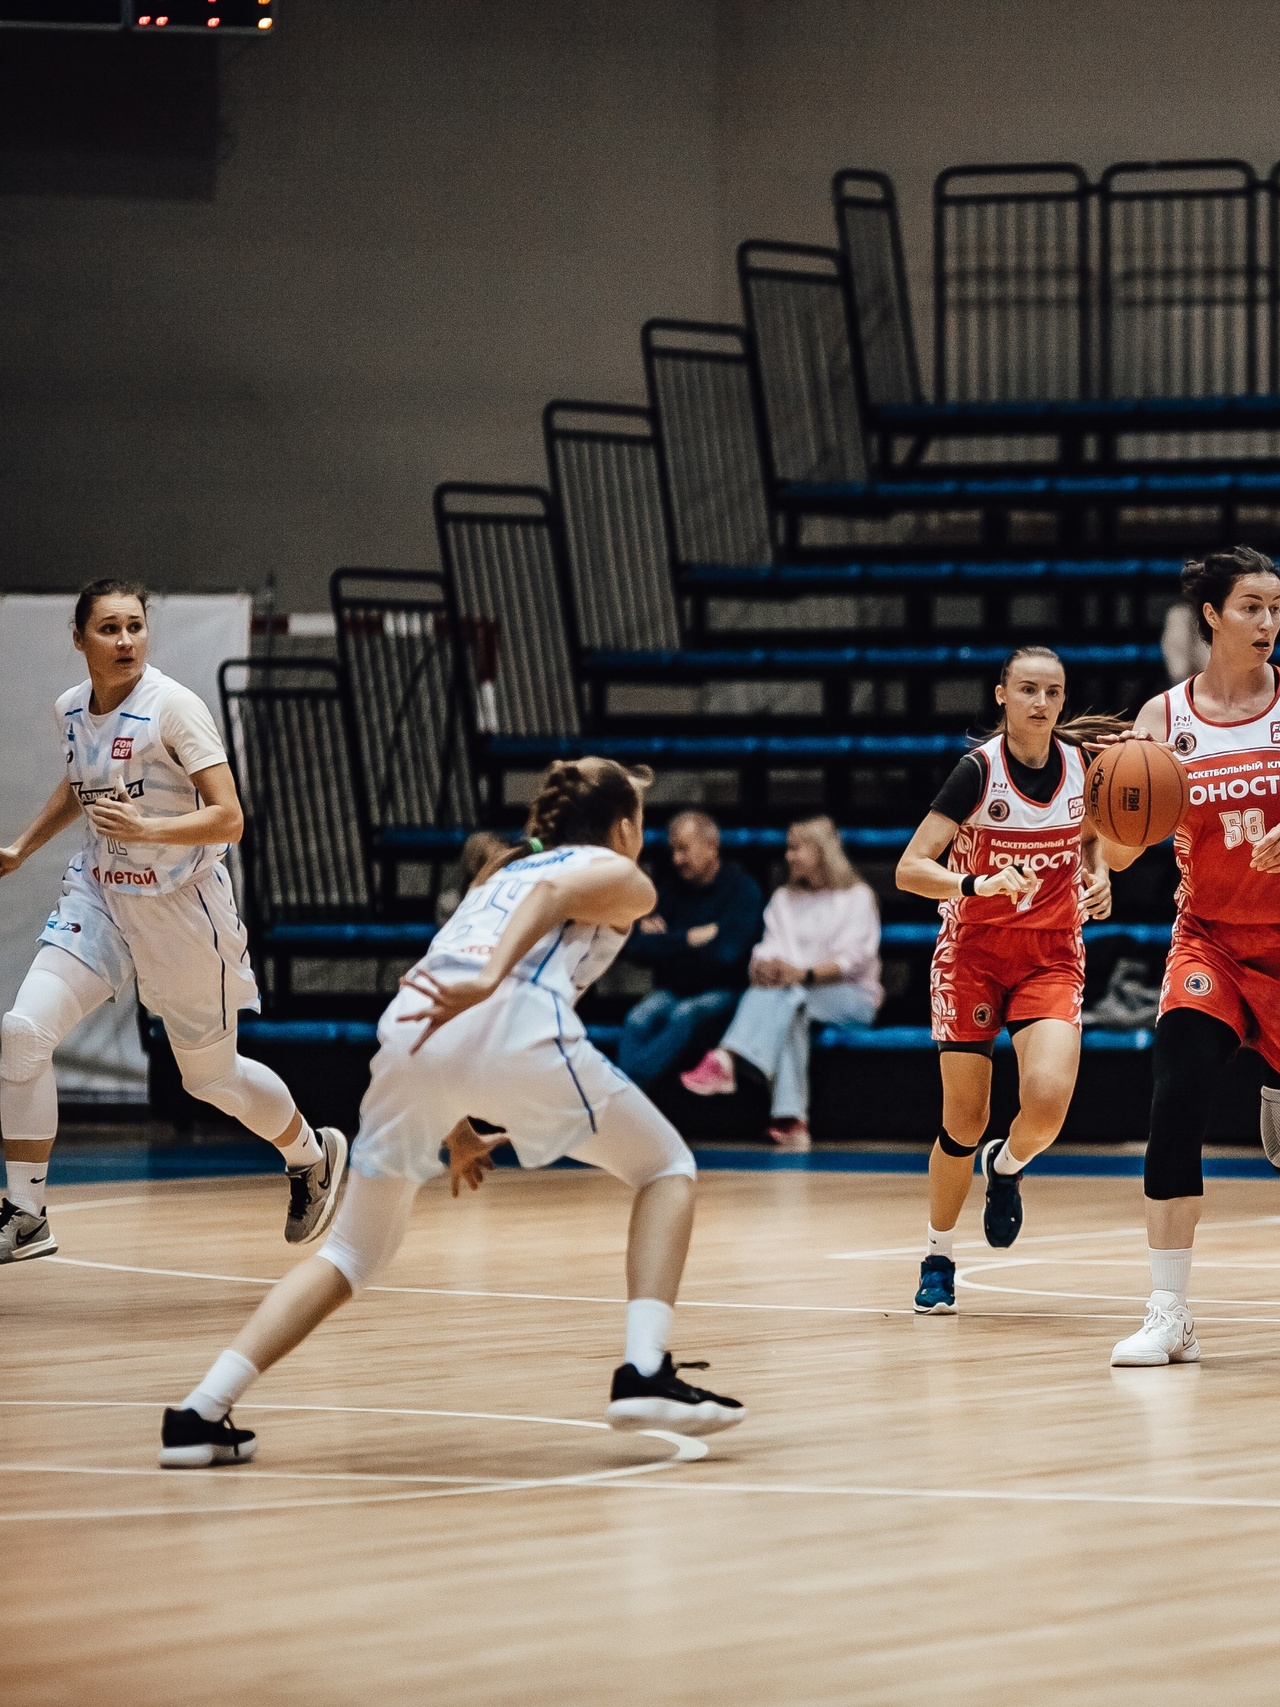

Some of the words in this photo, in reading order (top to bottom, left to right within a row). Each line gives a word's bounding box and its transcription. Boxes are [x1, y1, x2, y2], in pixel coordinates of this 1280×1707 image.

[112, 748, 130, 757] BET
[1187, 761, 1264, 780] АСКЕТБОЛЬНЫЙ
[1128, 787, 1140, 811] FIBA
[1219, 808, 1266, 850] 58
[988, 850, 1076, 872] ЮНОСТ
